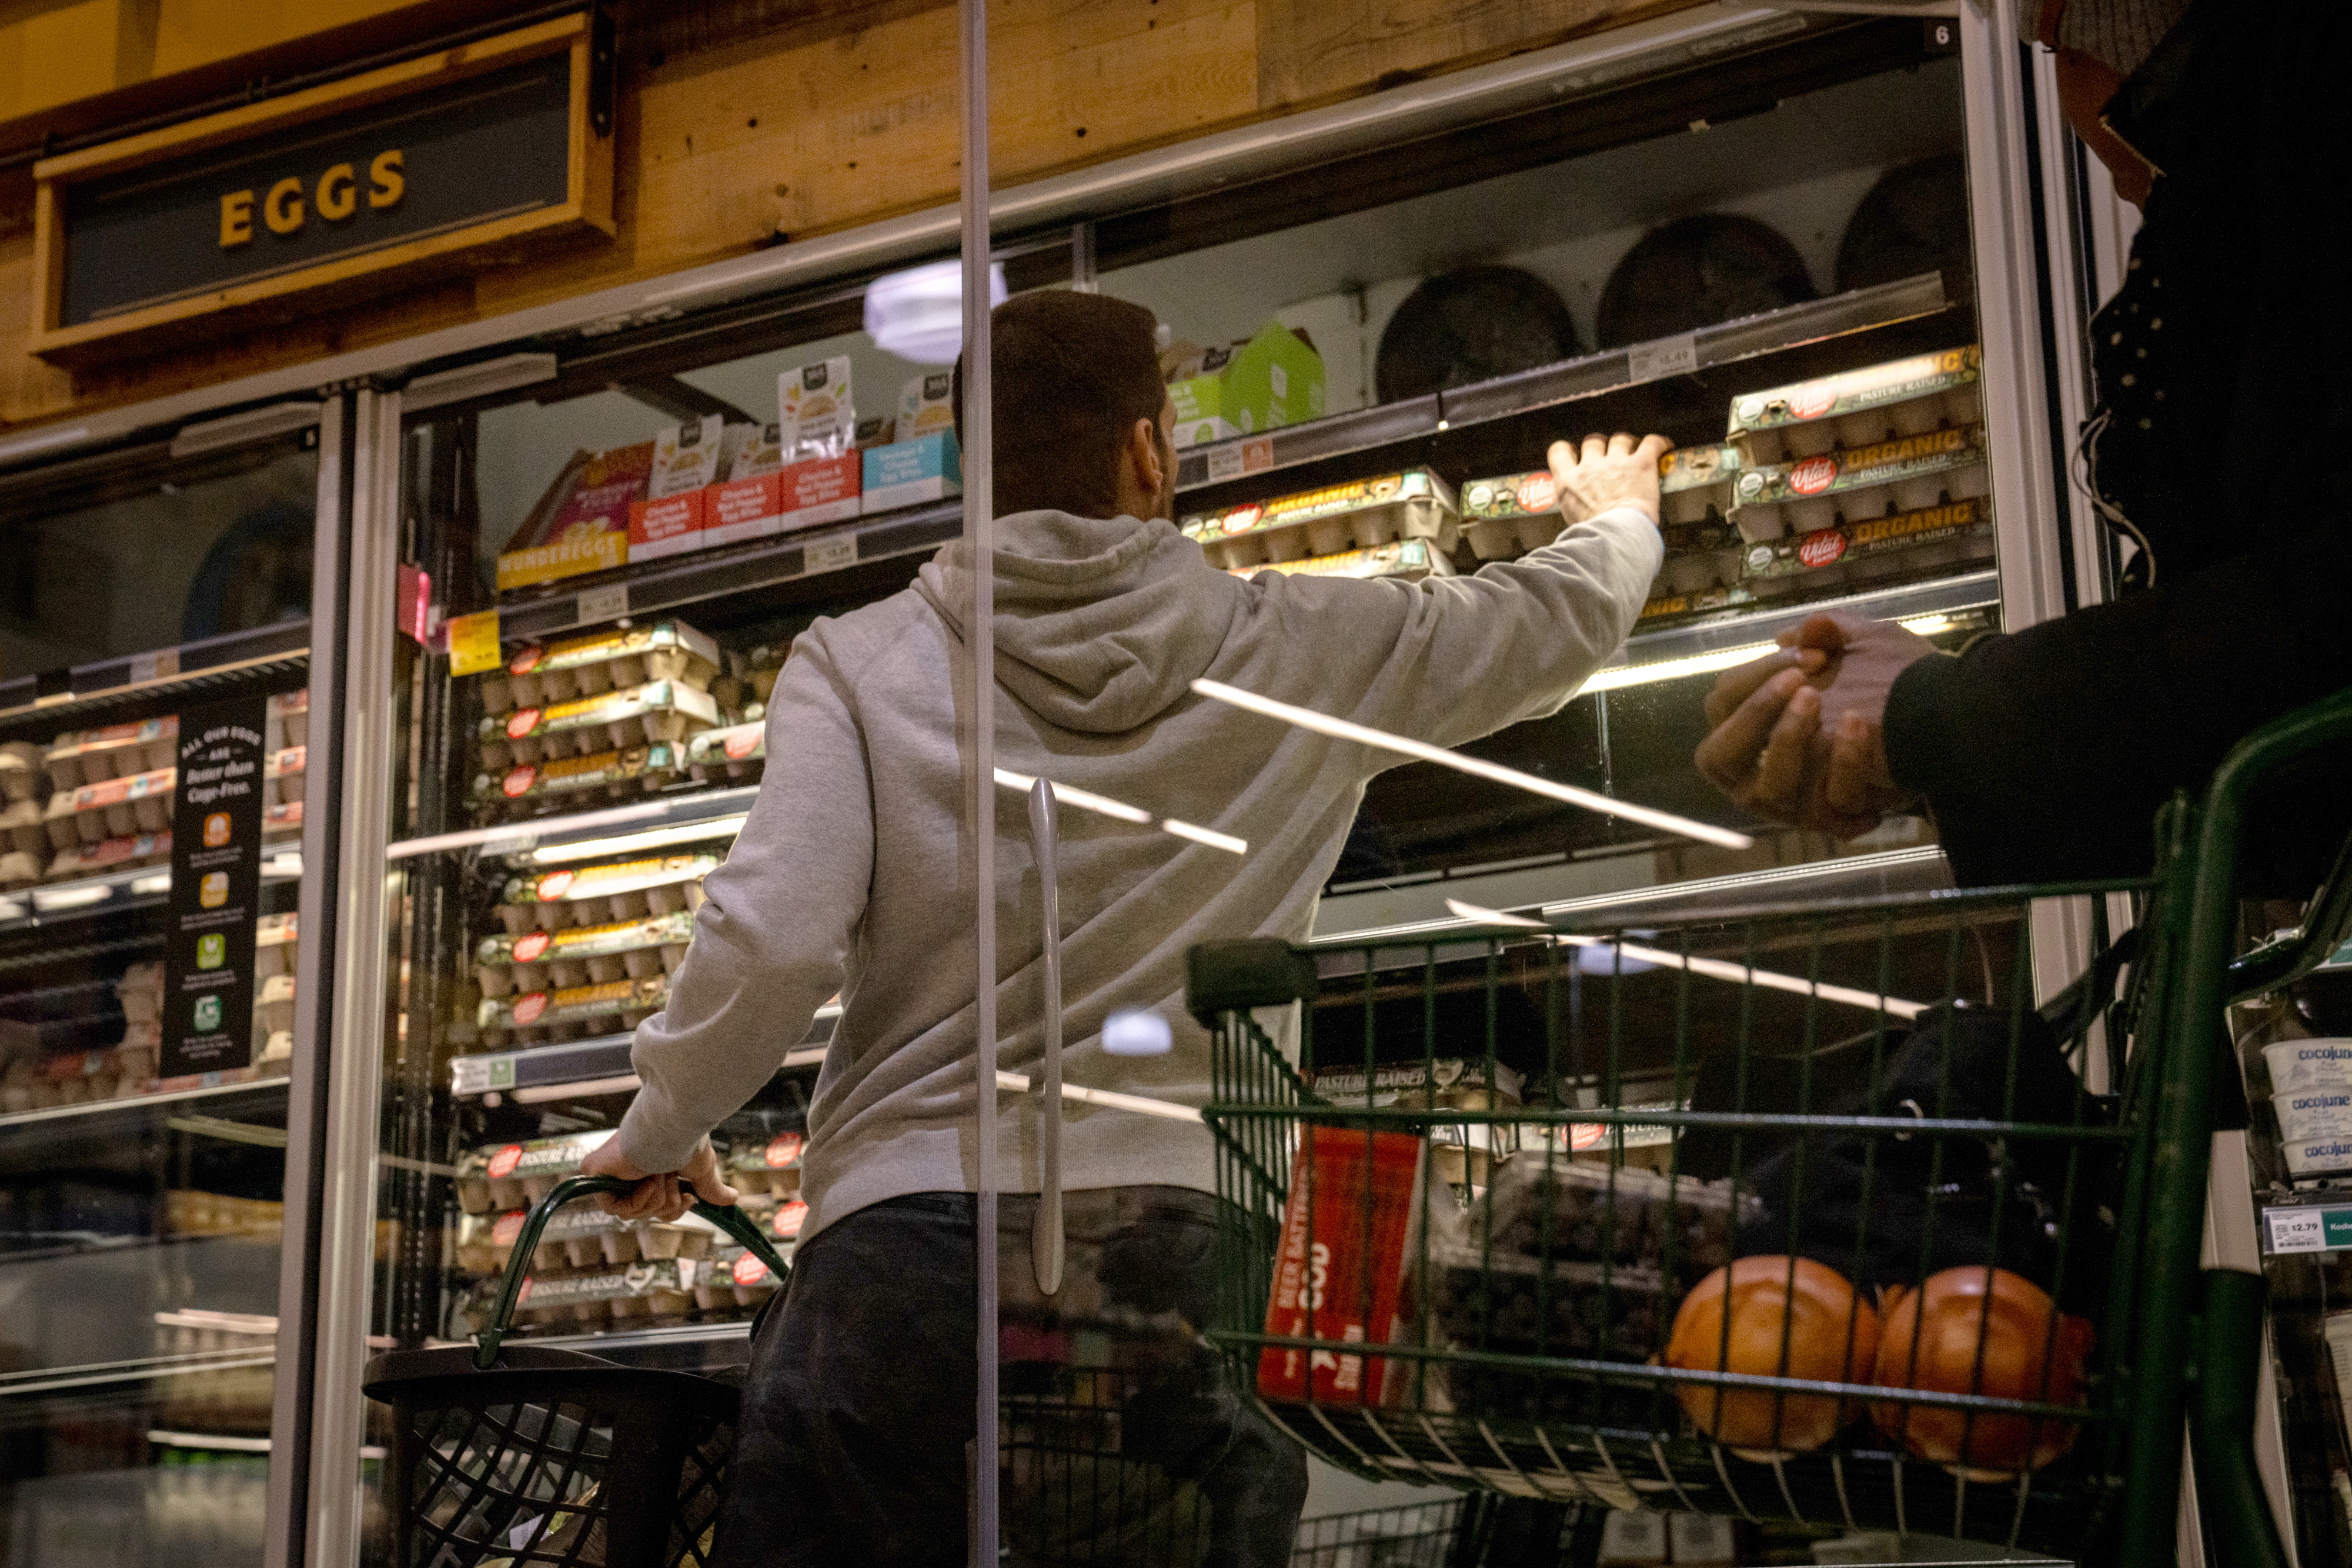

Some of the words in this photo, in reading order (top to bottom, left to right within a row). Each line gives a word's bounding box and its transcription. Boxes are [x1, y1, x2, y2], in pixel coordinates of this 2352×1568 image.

[1935, 25, 1949, 45] 6
[219, 150, 406, 248] EGGS
[1791, 382, 1832, 413] Vital
[1860, 385, 1903, 402] PASTURE
[1907, 375, 1946, 392] RAISED
[1847, 430, 1960, 469] ORGANIC
[1791, 459, 1832, 488] Vital
[1860, 462, 1903, 479] PASTURE
[1907, 454, 1947, 470] RAISED
[1268, 482, 1364, 513] ORGANIC
[1856, 504, 1970, 545] ORGANIC
[1915, 527, 1956, 543] RAISED
[1800, 534, 1841, 563] Vital
[1277, 550, 1361, 574] RGANIC
[181, 737, 204, 759] ALL
[203, 726, 229, 744] OUR
[230, 725, 262, 747] EGGS
[209, 746, 231, 761] ARE
[186, 767, 223, 785] Better
[224, 760, 255, 778] than
[2298, 1045, 2352, 1061] cocojun
[1375, 1066, 1426, 1089] RAISED
[2292, 1094, 2350, 1110] cocojune
[2292, 1222, 2318, 1232] $2.79
[1298, 1242, 1331, 1310] COD
